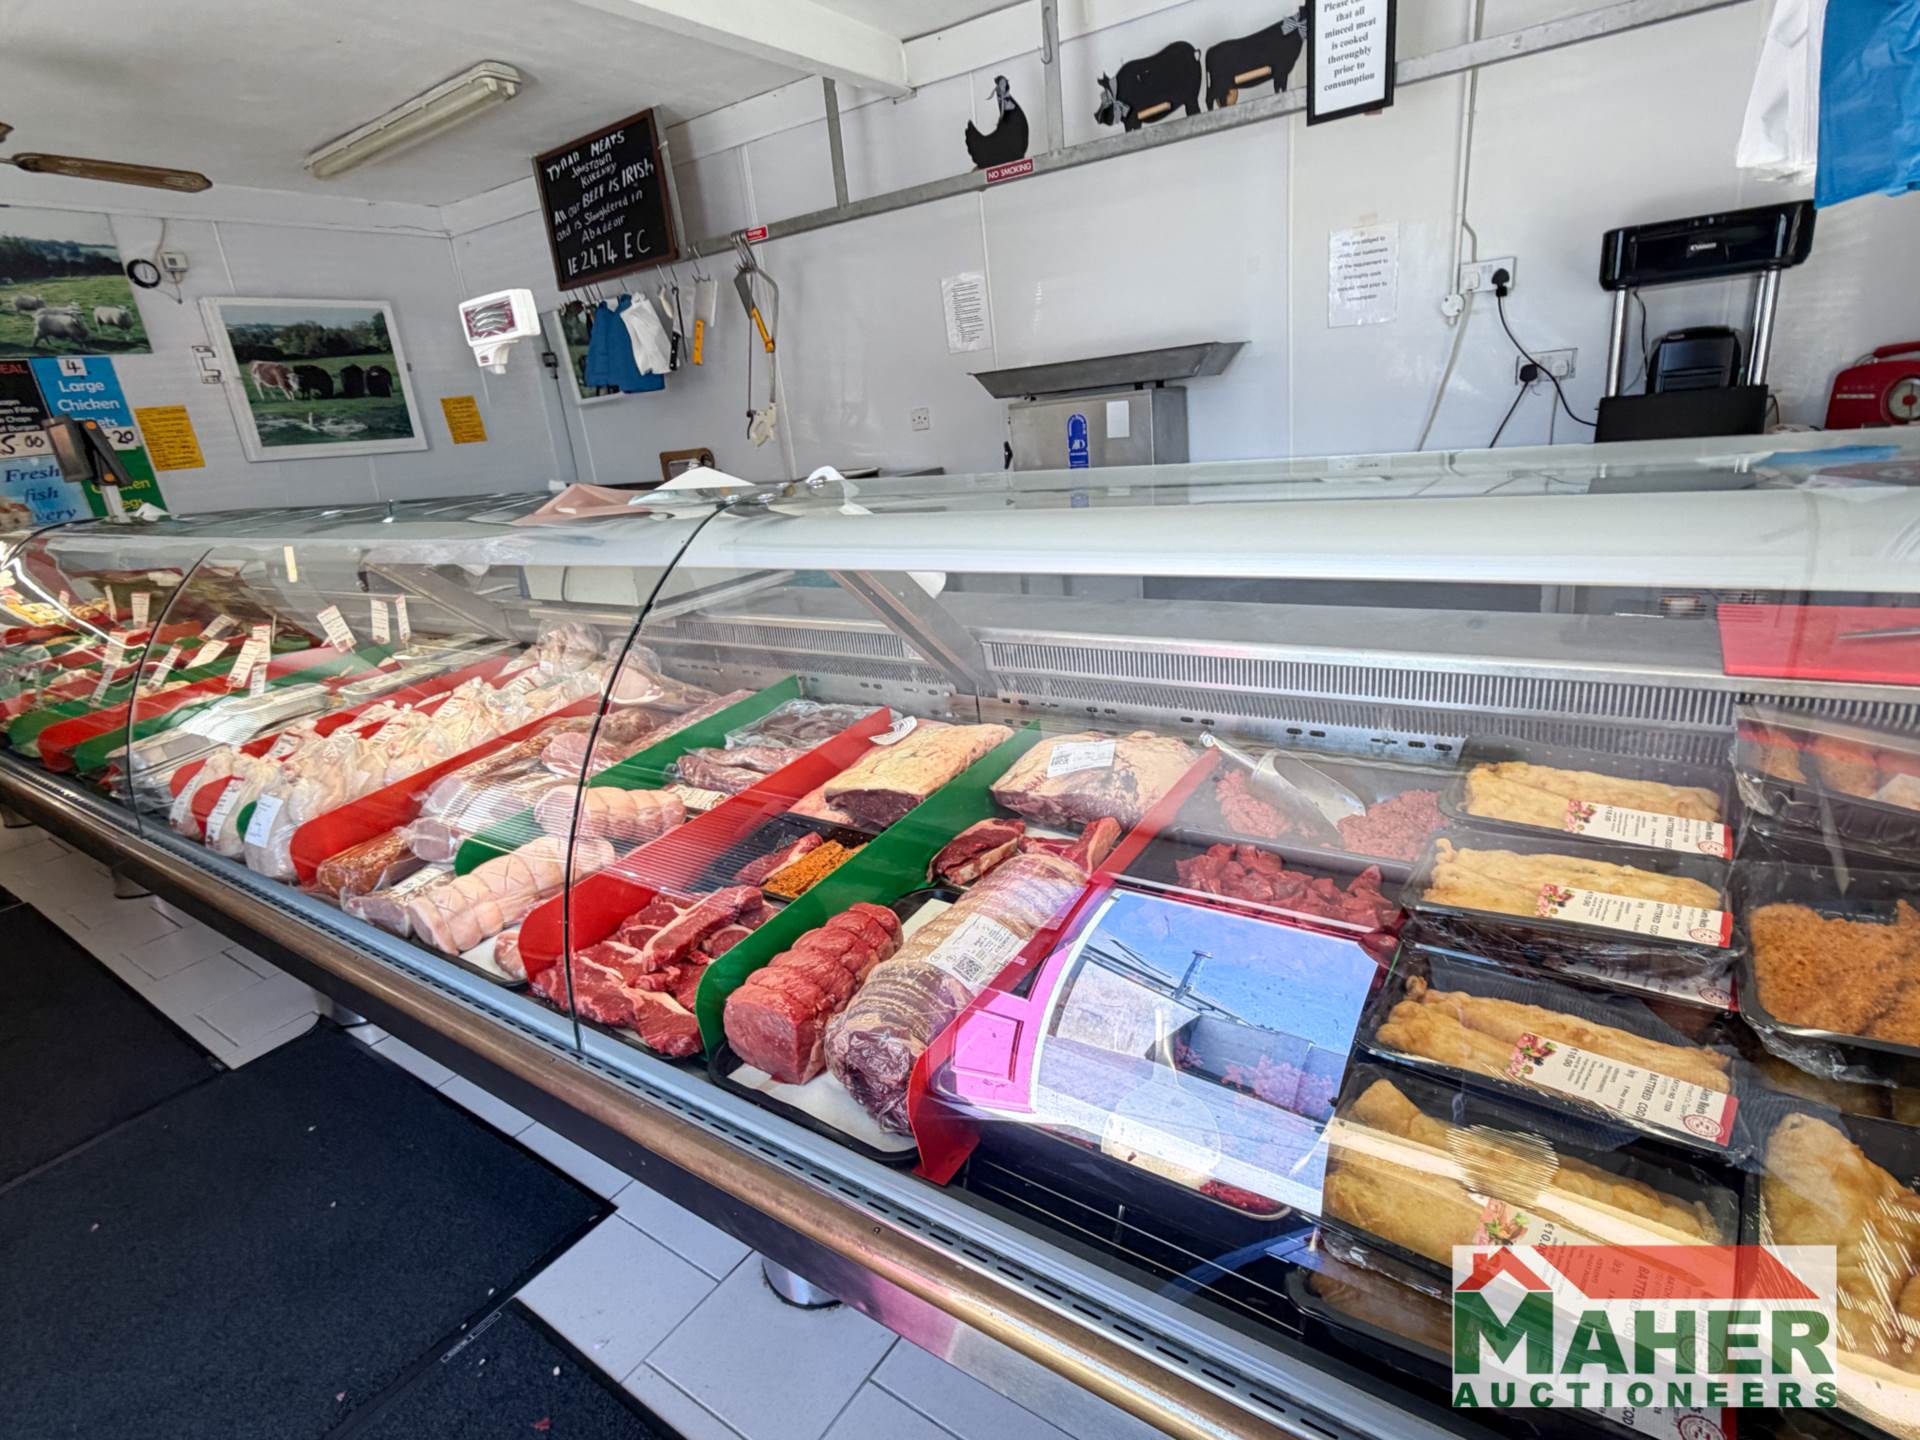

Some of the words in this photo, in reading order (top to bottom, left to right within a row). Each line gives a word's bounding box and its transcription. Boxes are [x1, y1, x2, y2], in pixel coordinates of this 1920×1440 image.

[1354, 6, 1366, 17] all
[1324, 23, 1354, 39] minced
[1356, 17, 1377, 30] meat
[1339, 31, 1369, 48] cooked
[1327, 45, 1373, 65] thoroughly
[1333, 64, 1356, 79] prior
[1323, 72, 1376, 92] consumption
[988, 171, 1000, 180] NO
[1001, 162, 1032, 177] SMOKING
[0, 363, 28, 375] EAL
[66, 360, 82, 374] 4
[57, 380, 105, 394] Large
[56, 398, 121, 412] Chicken
[5, 464, 60, 482] Fresh
[25, 486, 59, 503] fish
